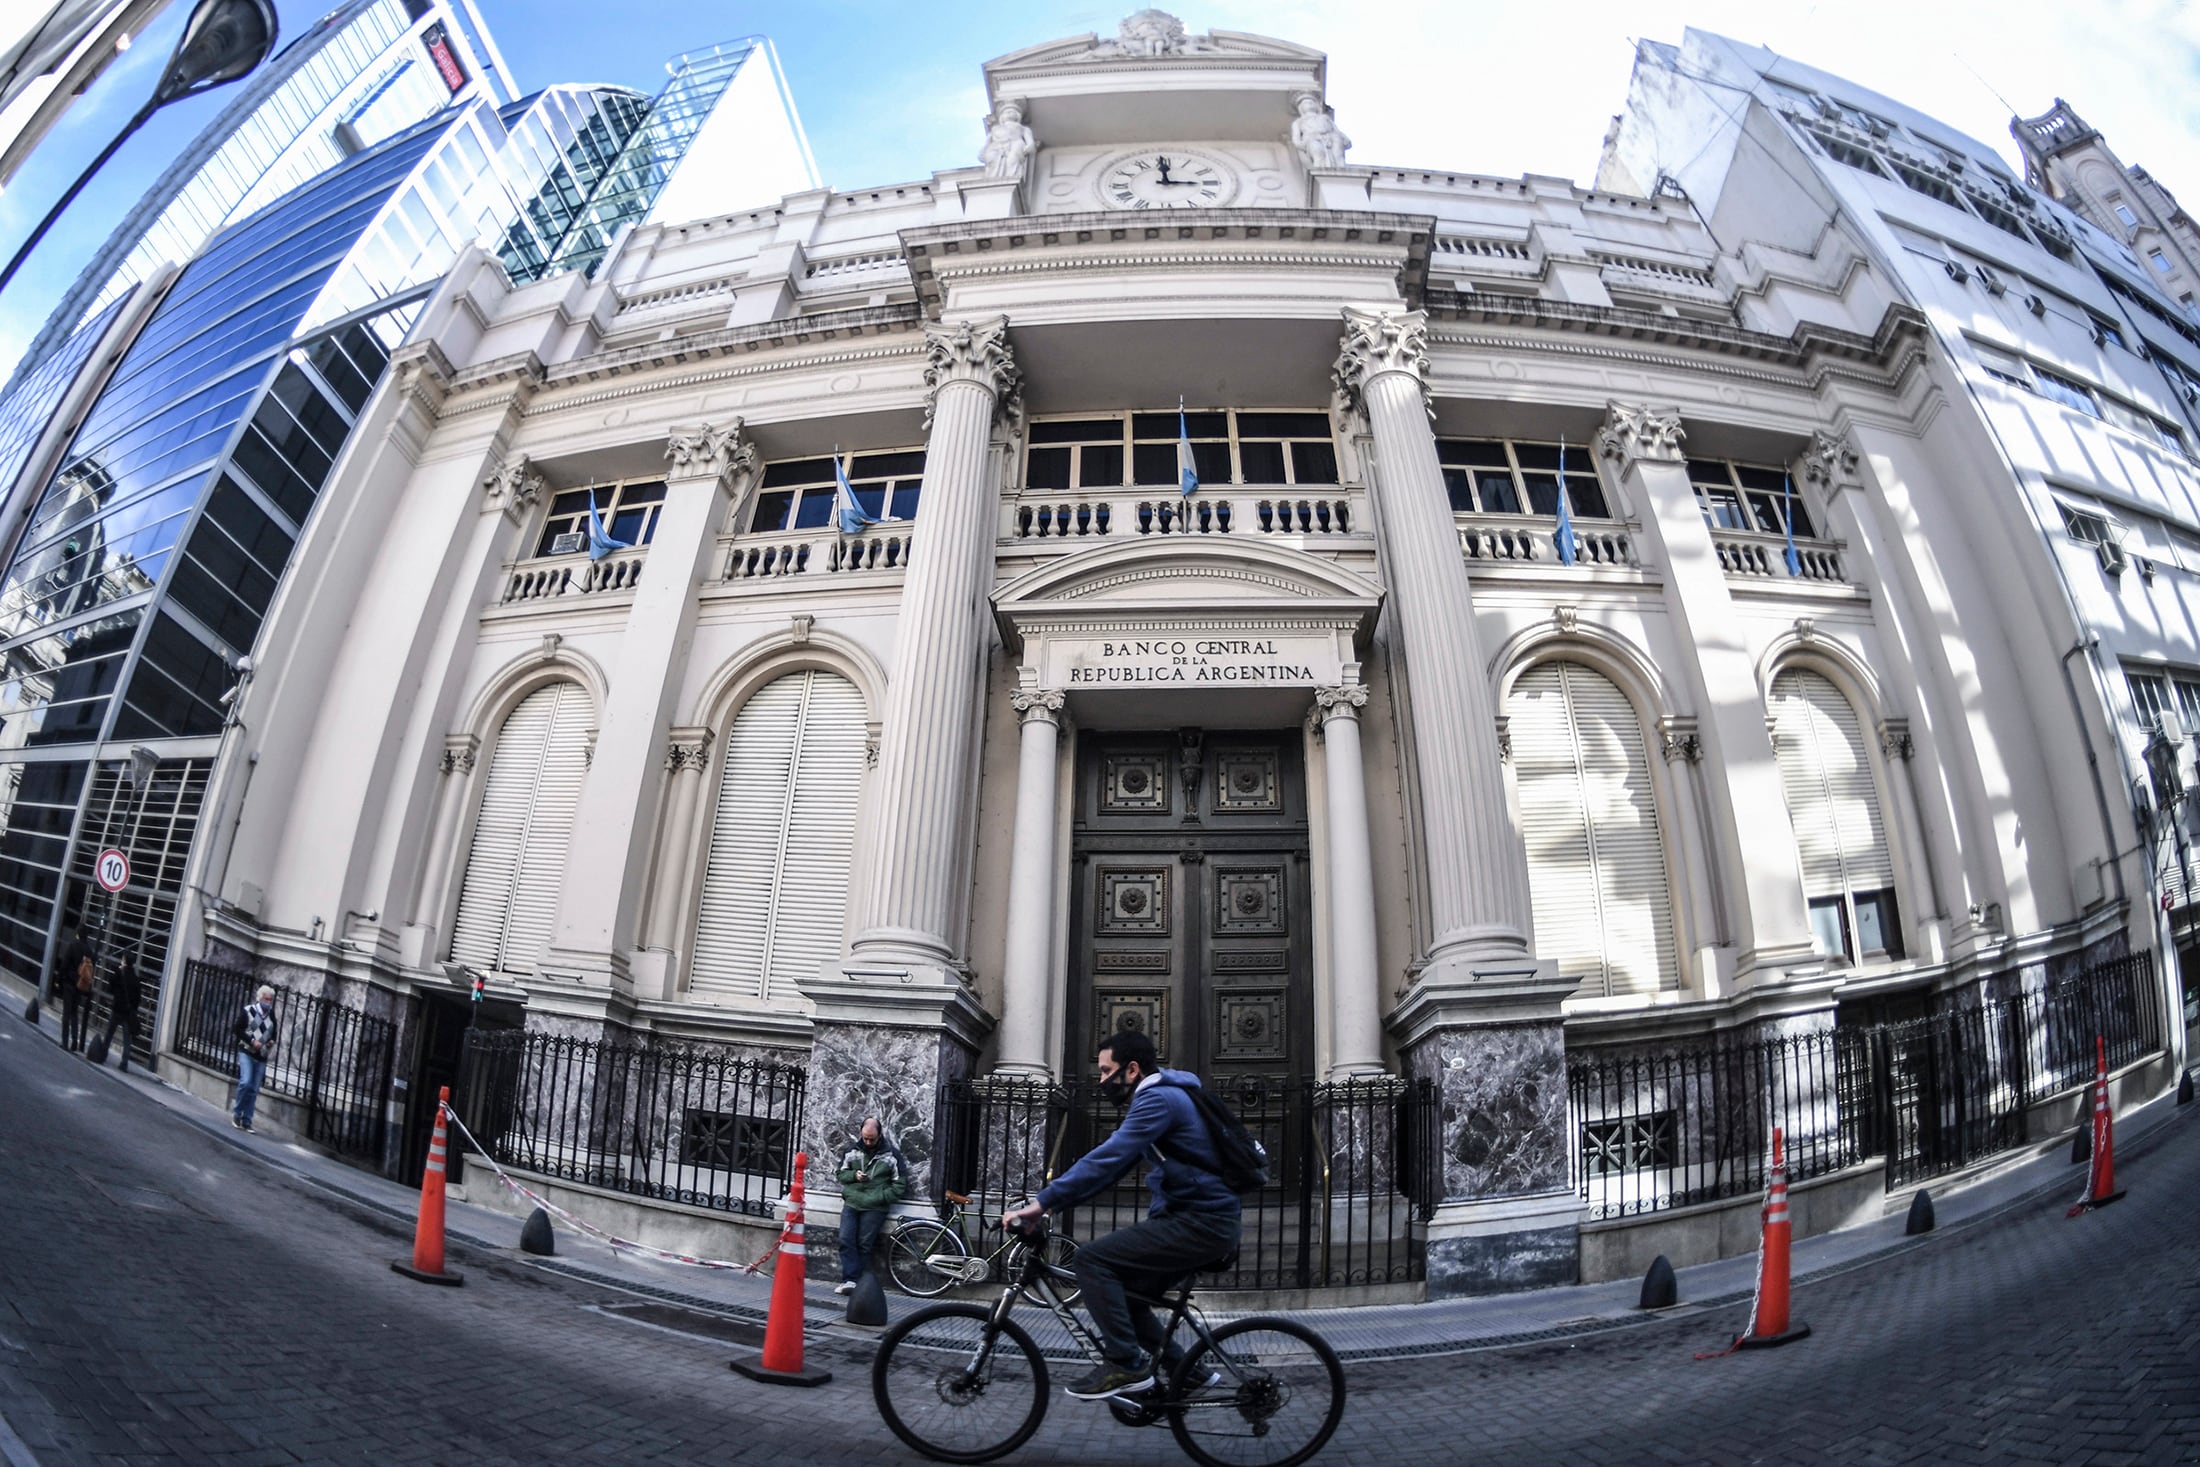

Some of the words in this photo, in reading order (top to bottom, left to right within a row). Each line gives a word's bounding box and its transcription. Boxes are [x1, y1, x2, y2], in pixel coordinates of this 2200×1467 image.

[438, 49, 458, 84] Galicia
[1103, 641, 1185, 656] BANCO
[1195, 640, 1277, 654] CENTRAL
[1173, 657, 1188, 665] DE
[1192, 657, 1207, 665] LA
[1070, 667, 1185, 682] REPUBLICA
[1196, 666, 1314, 681] ARGENTINA
[106, 859, 122, 882] 10
